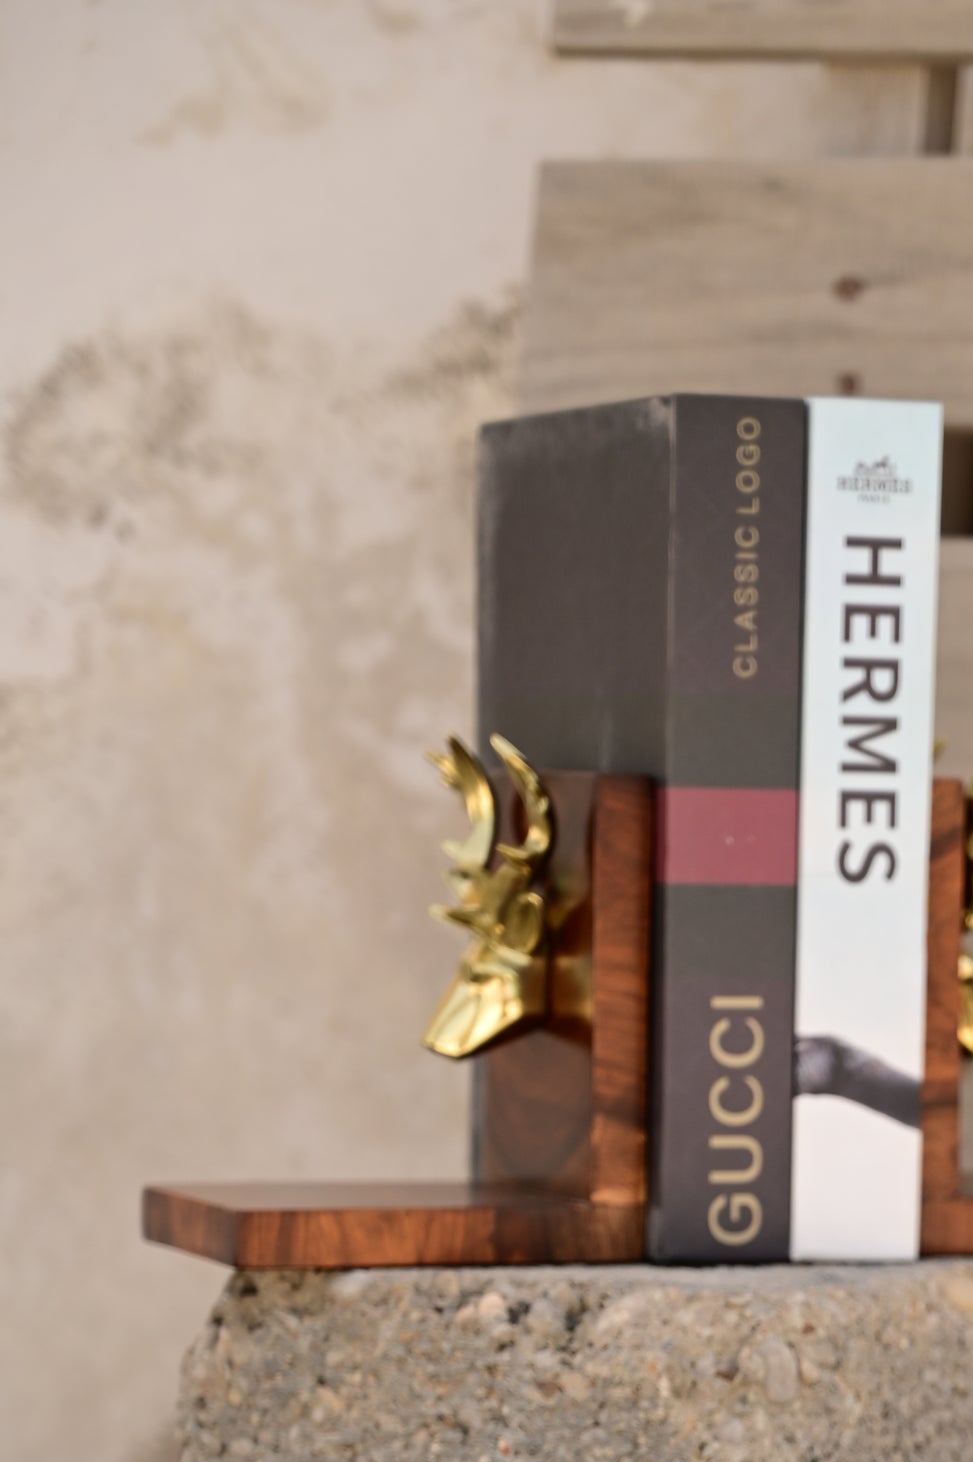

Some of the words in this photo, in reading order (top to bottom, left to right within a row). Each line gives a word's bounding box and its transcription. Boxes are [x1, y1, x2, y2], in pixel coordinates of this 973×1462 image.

[736, 416, 762, 516] LOGO
[733, 525, 760, 680] CLASSIC
[837, 535, 904, 885] HERMES
[707, 996, 764, 1246] GUCCI
